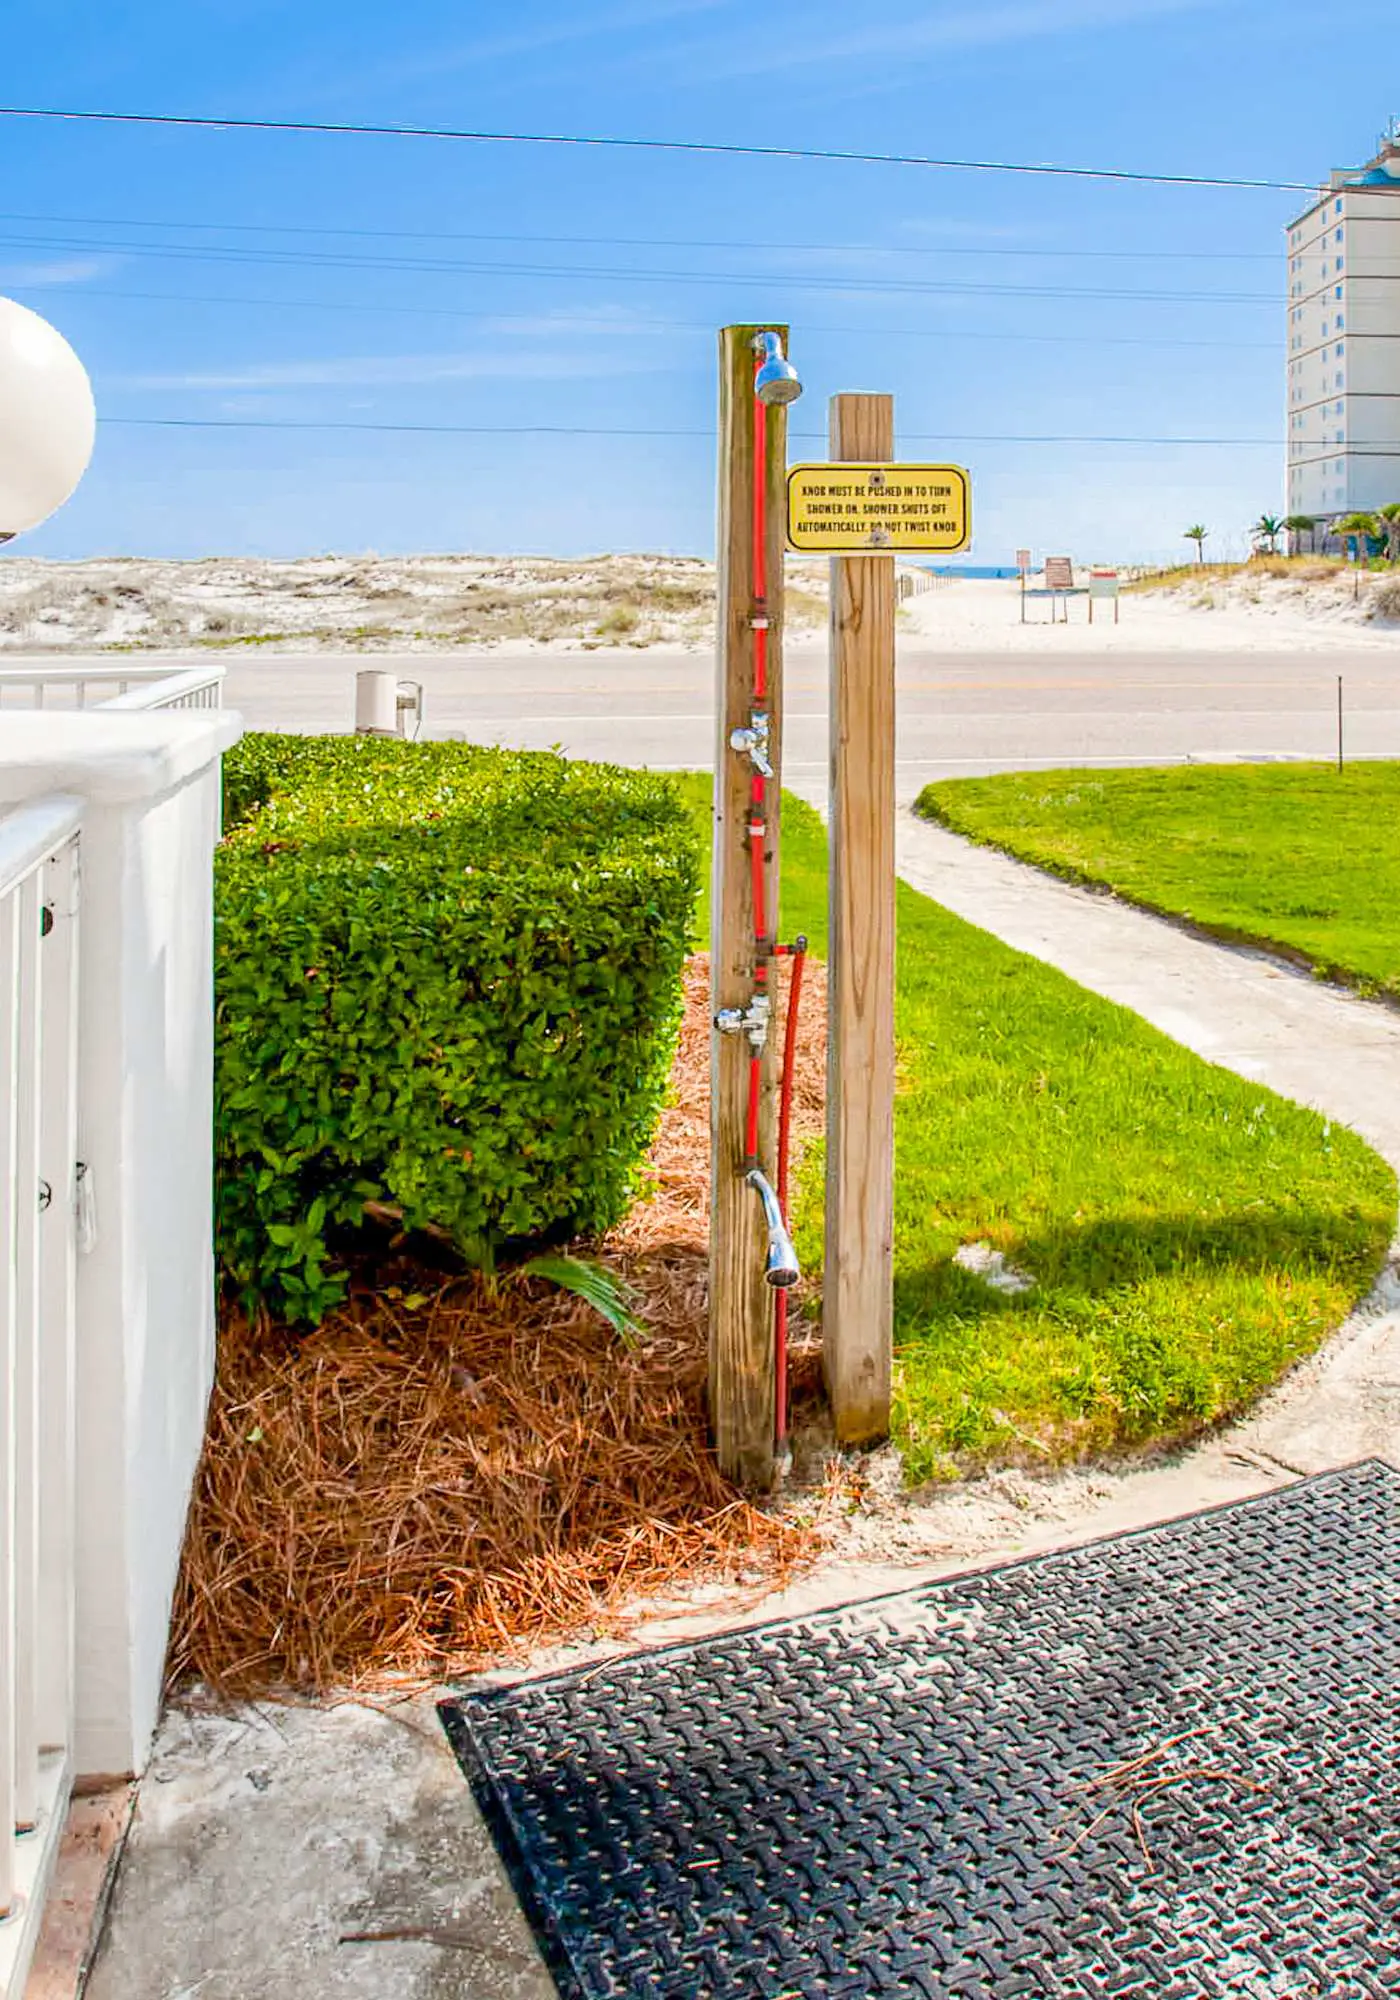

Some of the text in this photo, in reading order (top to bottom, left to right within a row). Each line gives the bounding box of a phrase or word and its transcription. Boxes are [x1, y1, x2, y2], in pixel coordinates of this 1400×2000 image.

[802, 486, 951, 497] KNOB MUST BE PUSHED IN TO TURN
[807, 503, 843, 514] SHOWER
[863, 503, 900, 514] SHOWER
[901, 503, 929, 514] SHUTS
[930, 503, 947, 514] OFF
[884, 521, 902, 532] NOT
[904, 521, 931, 532] TWIST
[932, 521, 956, 532] KNOB
